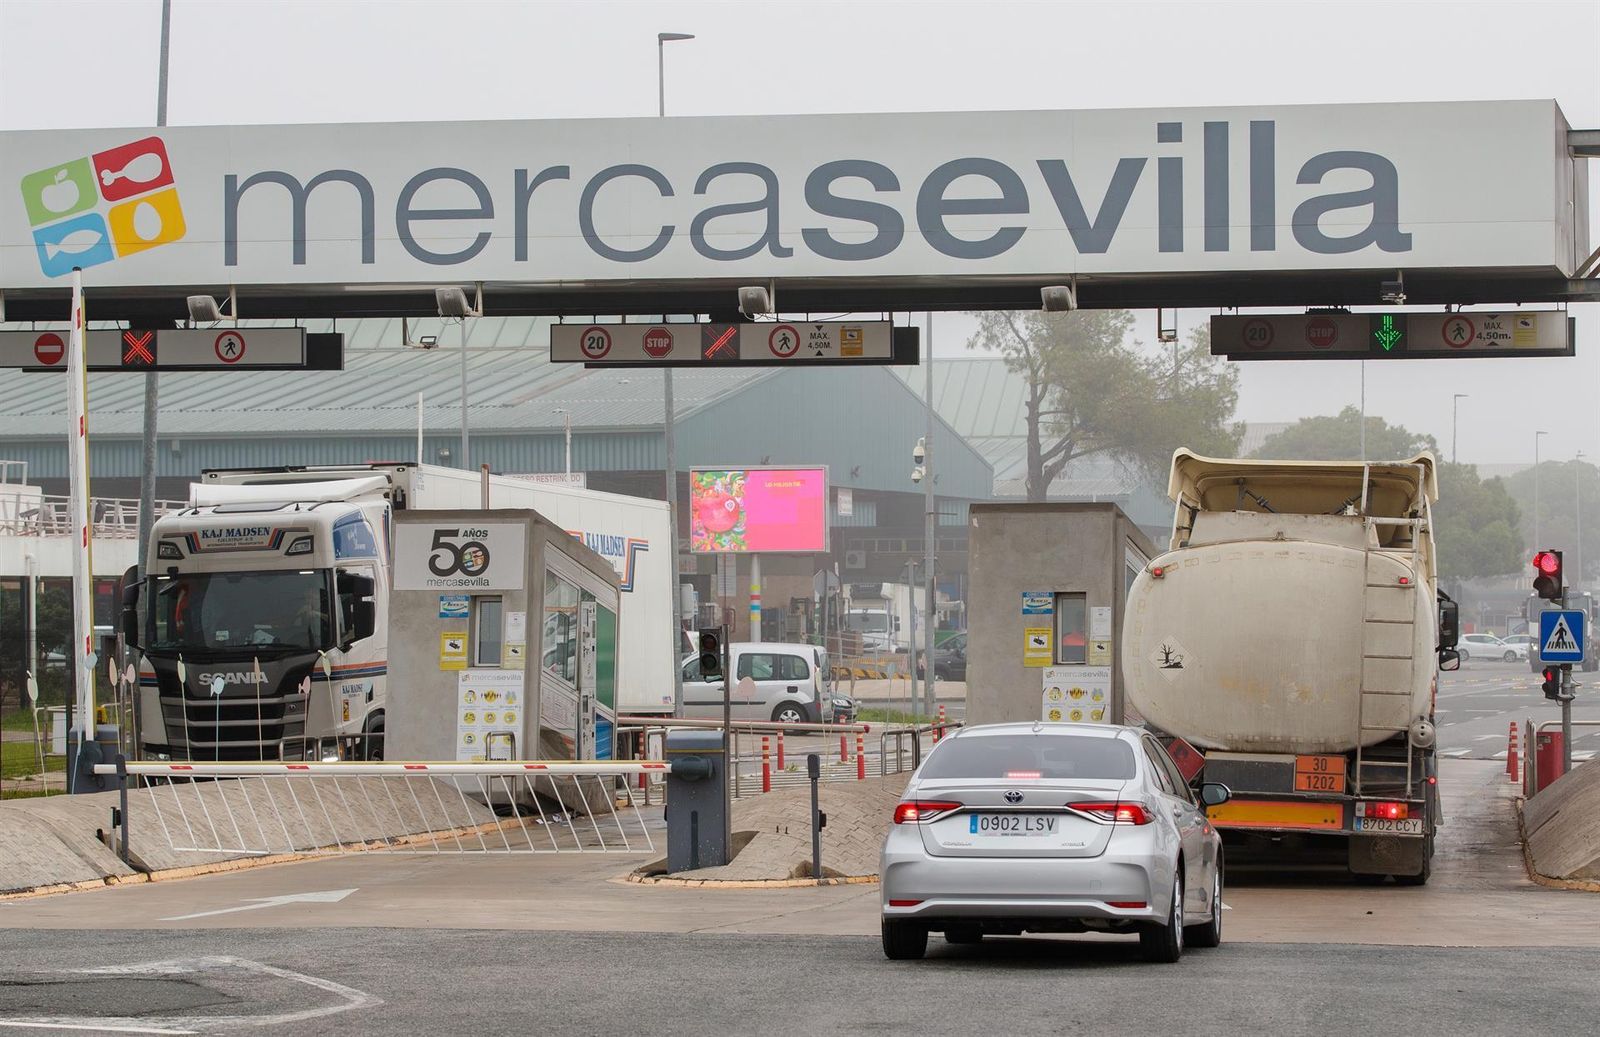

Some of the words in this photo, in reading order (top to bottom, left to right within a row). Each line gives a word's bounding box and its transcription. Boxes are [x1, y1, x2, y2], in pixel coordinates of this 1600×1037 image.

[224, 119, 1413, 267] mercasevilla
[809, 332, 830, 340] MAX.
[1248, 327, 1267, 341] 20
[1309, 327, 1335, 338] STOP
[1476, 331, 1512, 340] 4,50m.
[587, 336, 605, 350] 20
[646, 337, 670, 348] STOP
[807, 341, 833, 350] 4,50M.
[202, 528, 223, 538] KAJ
[225, 527, 271, 537] MADSEN
[428, 528, 491, 577] 50
[462, 527, 489, 538] AÑOS
[600, 534, 626, 557] MADSEN
[426, 577, 490, 588] mercasevilla
[198, 672, 269, 685] SCANIA
[471, 673, 522, 681] mercasevilla
[1056, 670, 1109, 678] mercasevilla
[1312, 757, 1328, 772] 30
[1306, 775, 1336, 790] 1202
[980, 816, 1020, 831] 0902
[1025, 816, 1056, 831] LSV
[1362, 818, 1393, 831] 8702
[1395, 820, 1419, 832] CCY
